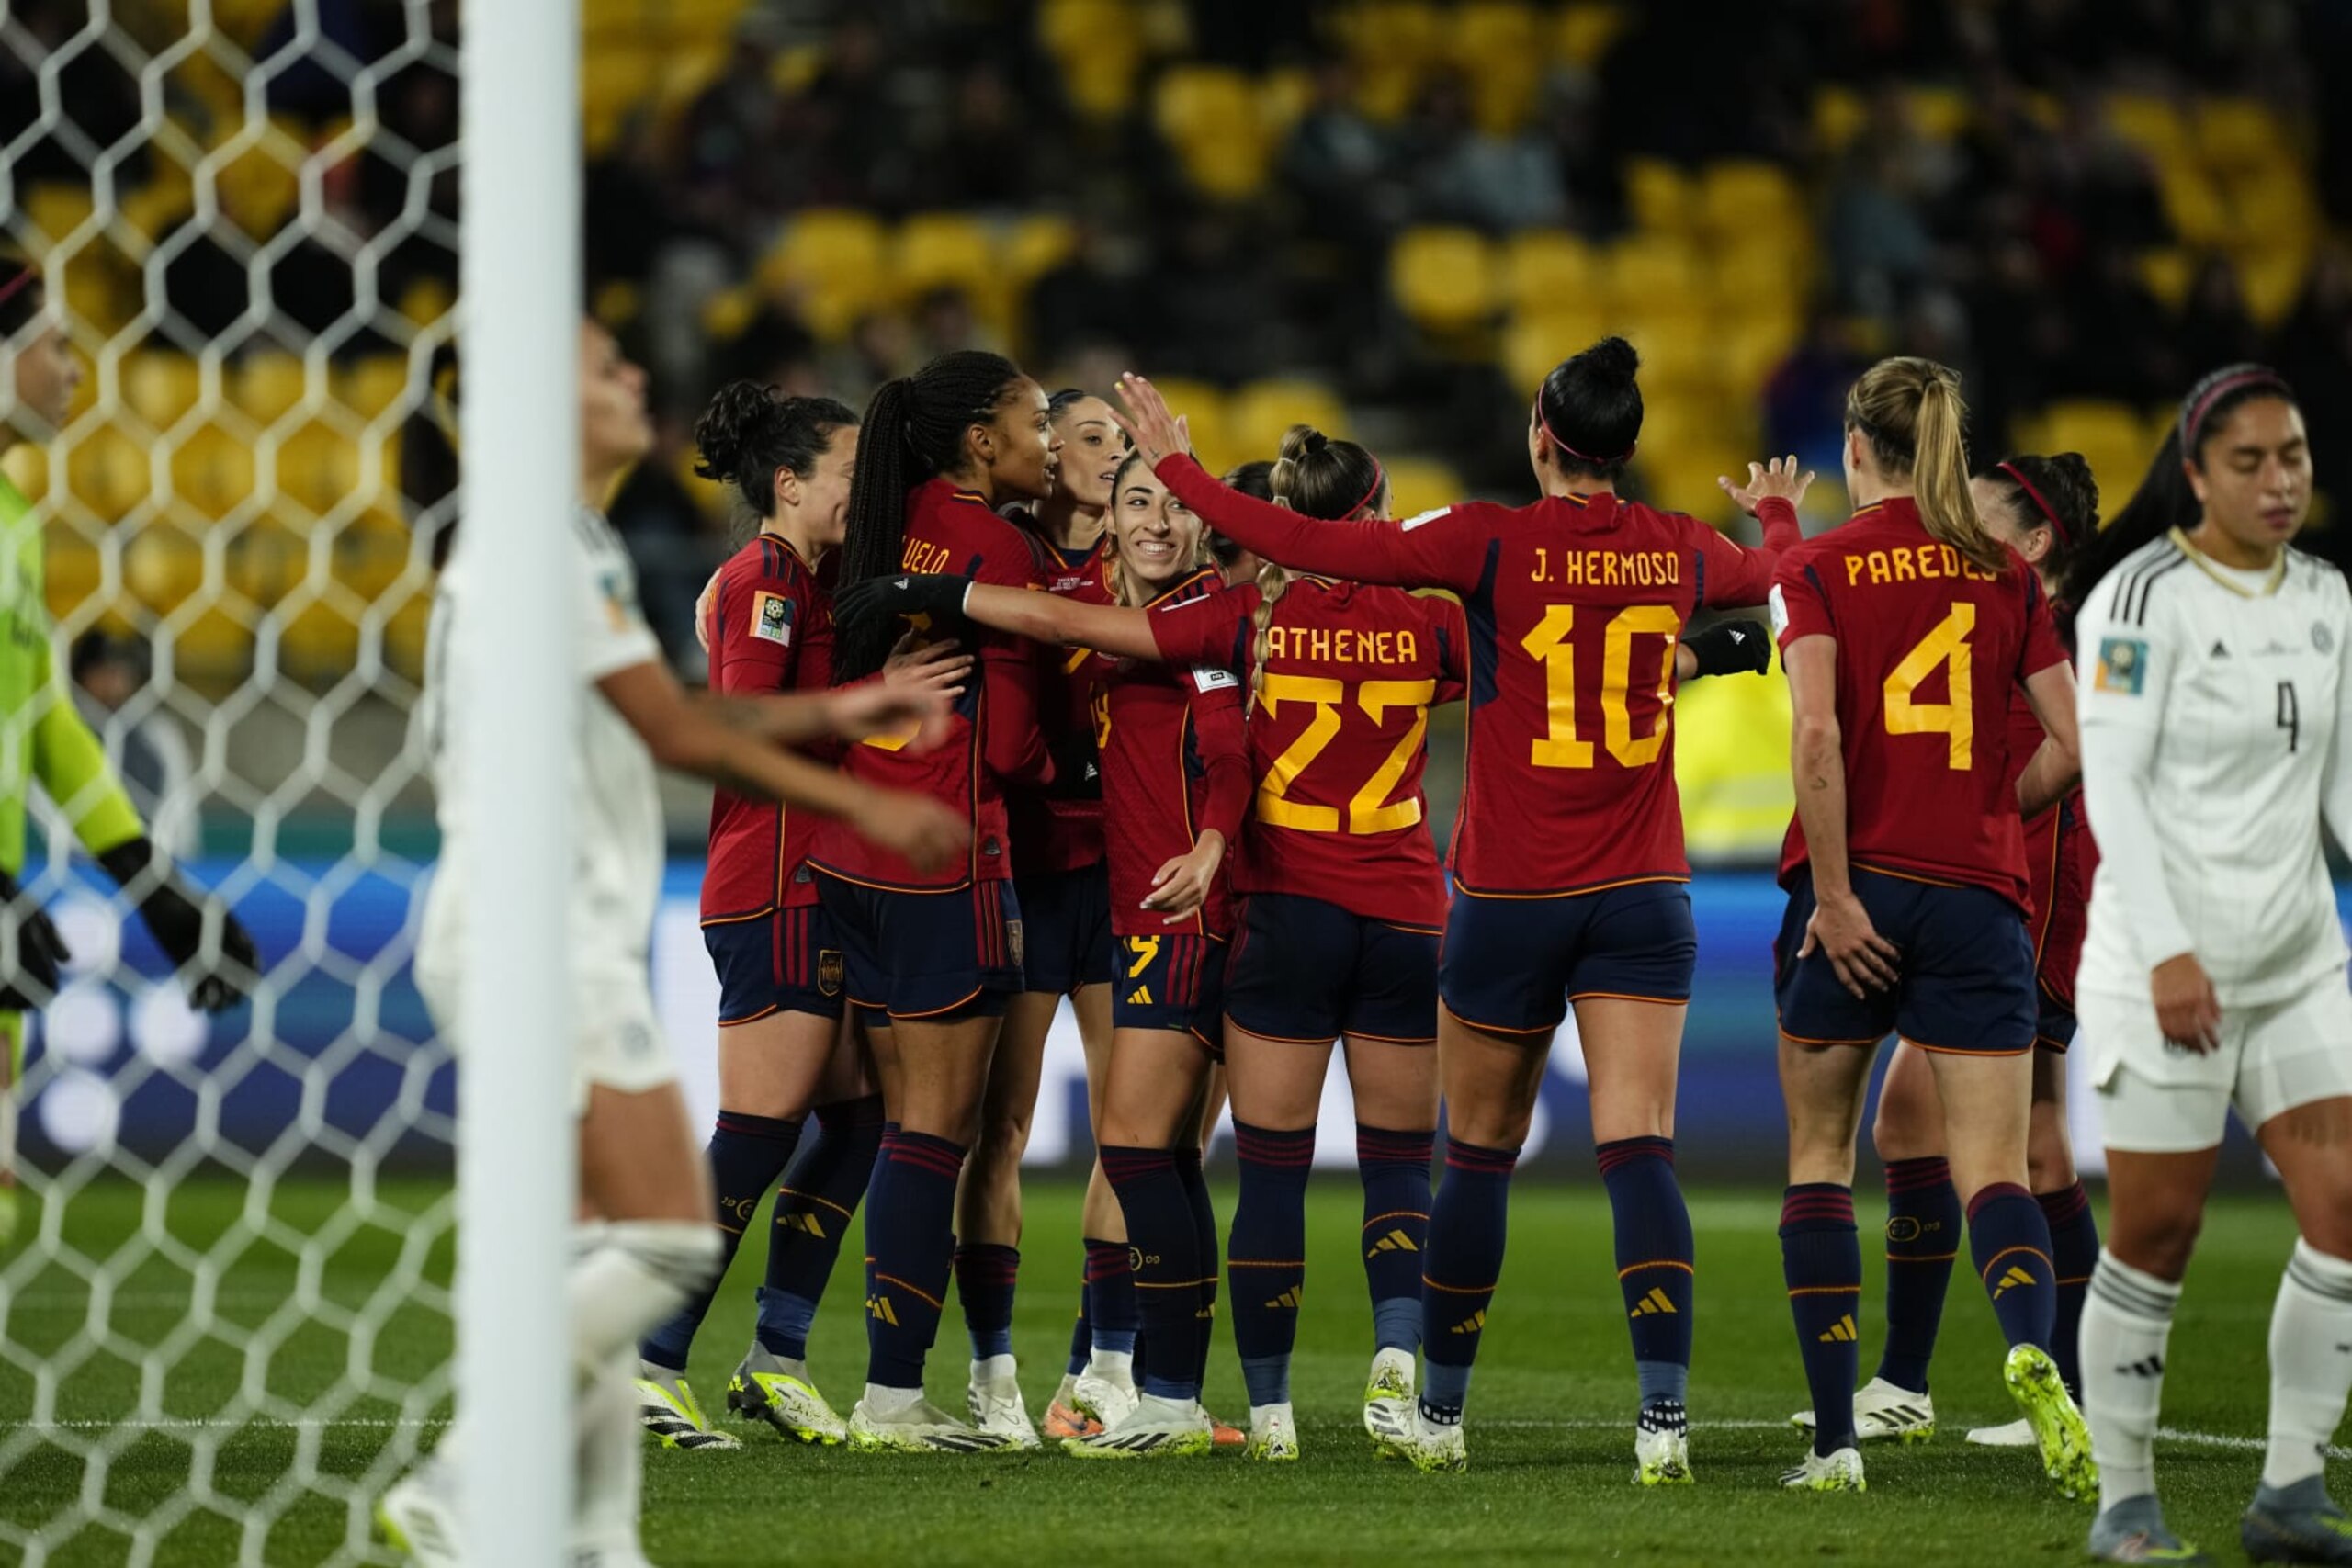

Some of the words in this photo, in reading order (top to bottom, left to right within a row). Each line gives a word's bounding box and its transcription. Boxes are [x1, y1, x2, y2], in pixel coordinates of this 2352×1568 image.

[902, 535, 950, 574] UELO
[1531, 548, 1555, 582] J.
[1566, 551, 1679, 586] HERMOSO
[1267, 626, 1418, 664] ATHENEA
[1521, 604, 1681, 769] 10
[1883, 601, 1976, 772] 4
[1255, 672, 1437, 835] 22
